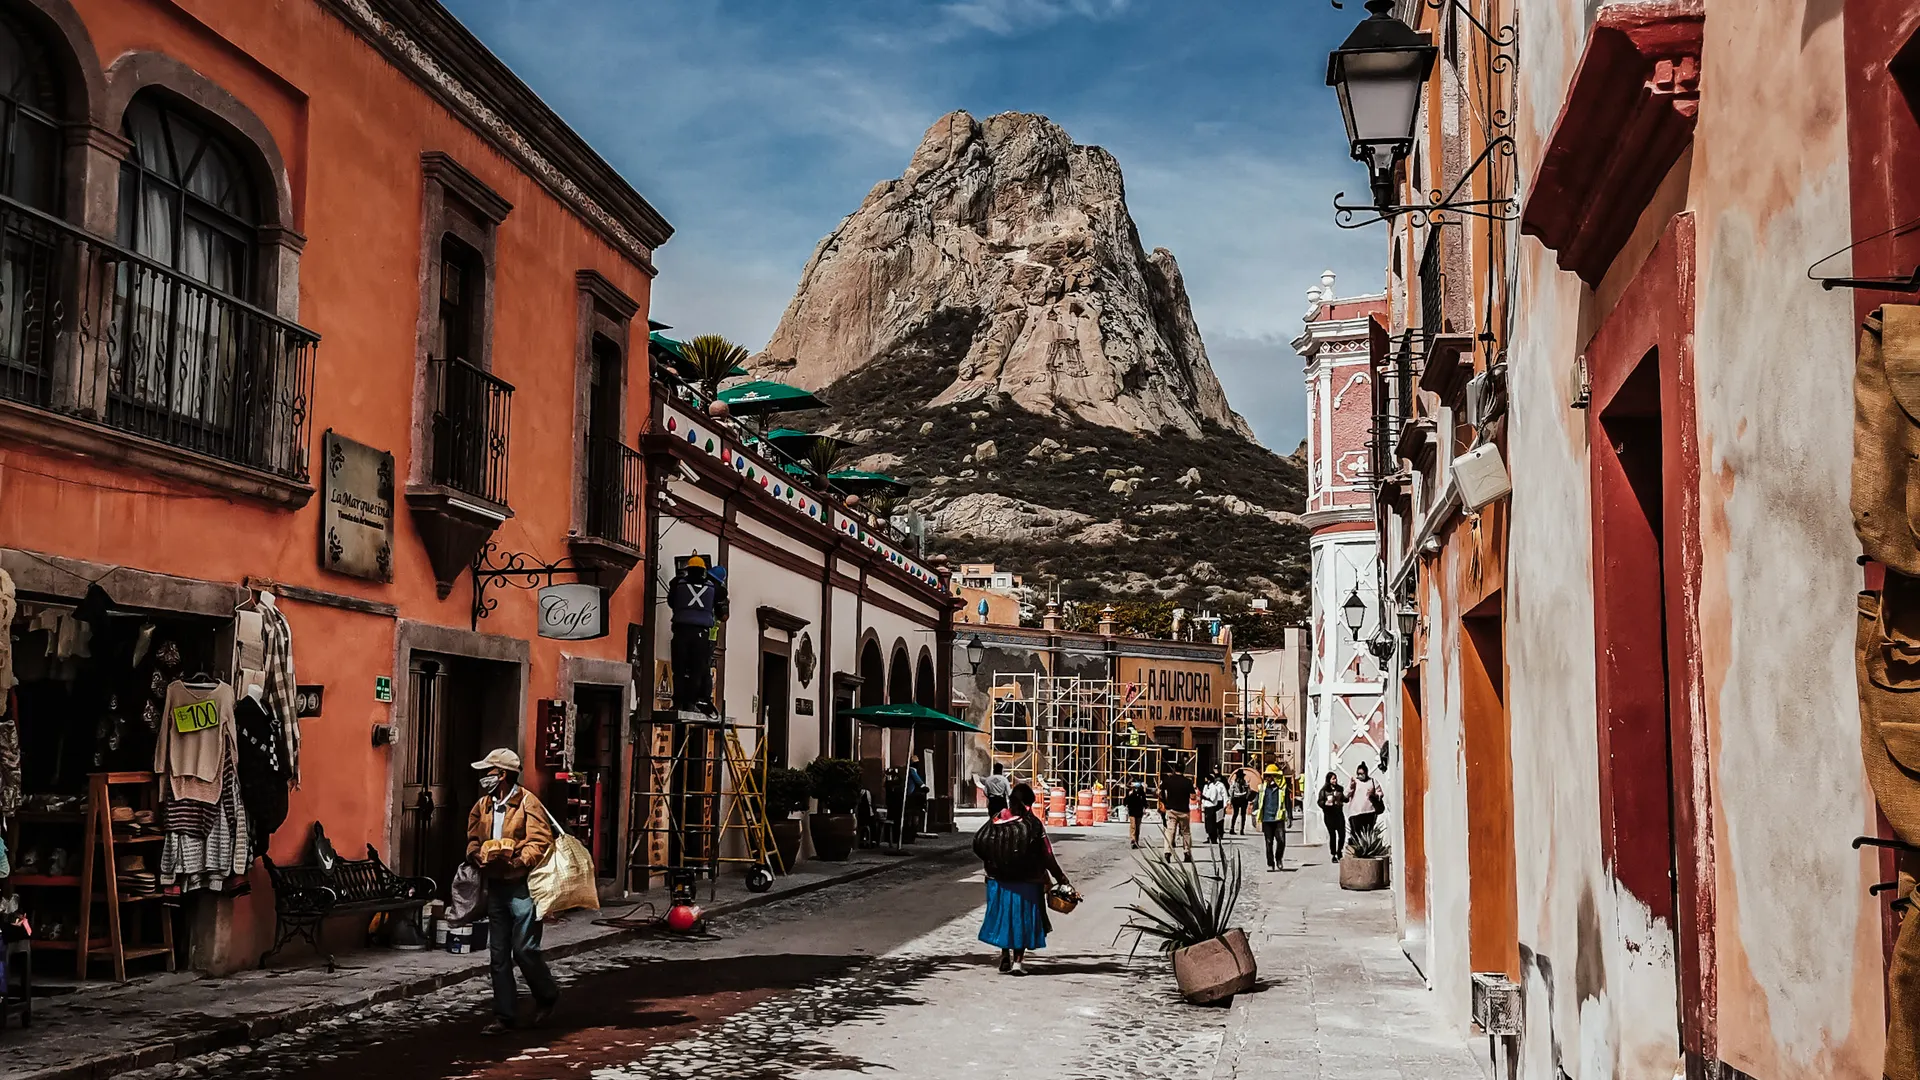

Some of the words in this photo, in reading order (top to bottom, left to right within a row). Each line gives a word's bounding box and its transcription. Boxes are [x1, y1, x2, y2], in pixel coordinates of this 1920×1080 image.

[331, 488, 342, 504] La
[541, 594, 597, 635] Café
[1158, 669, 1211, 703] AURORA
[177, 702, 218, 729] $100
